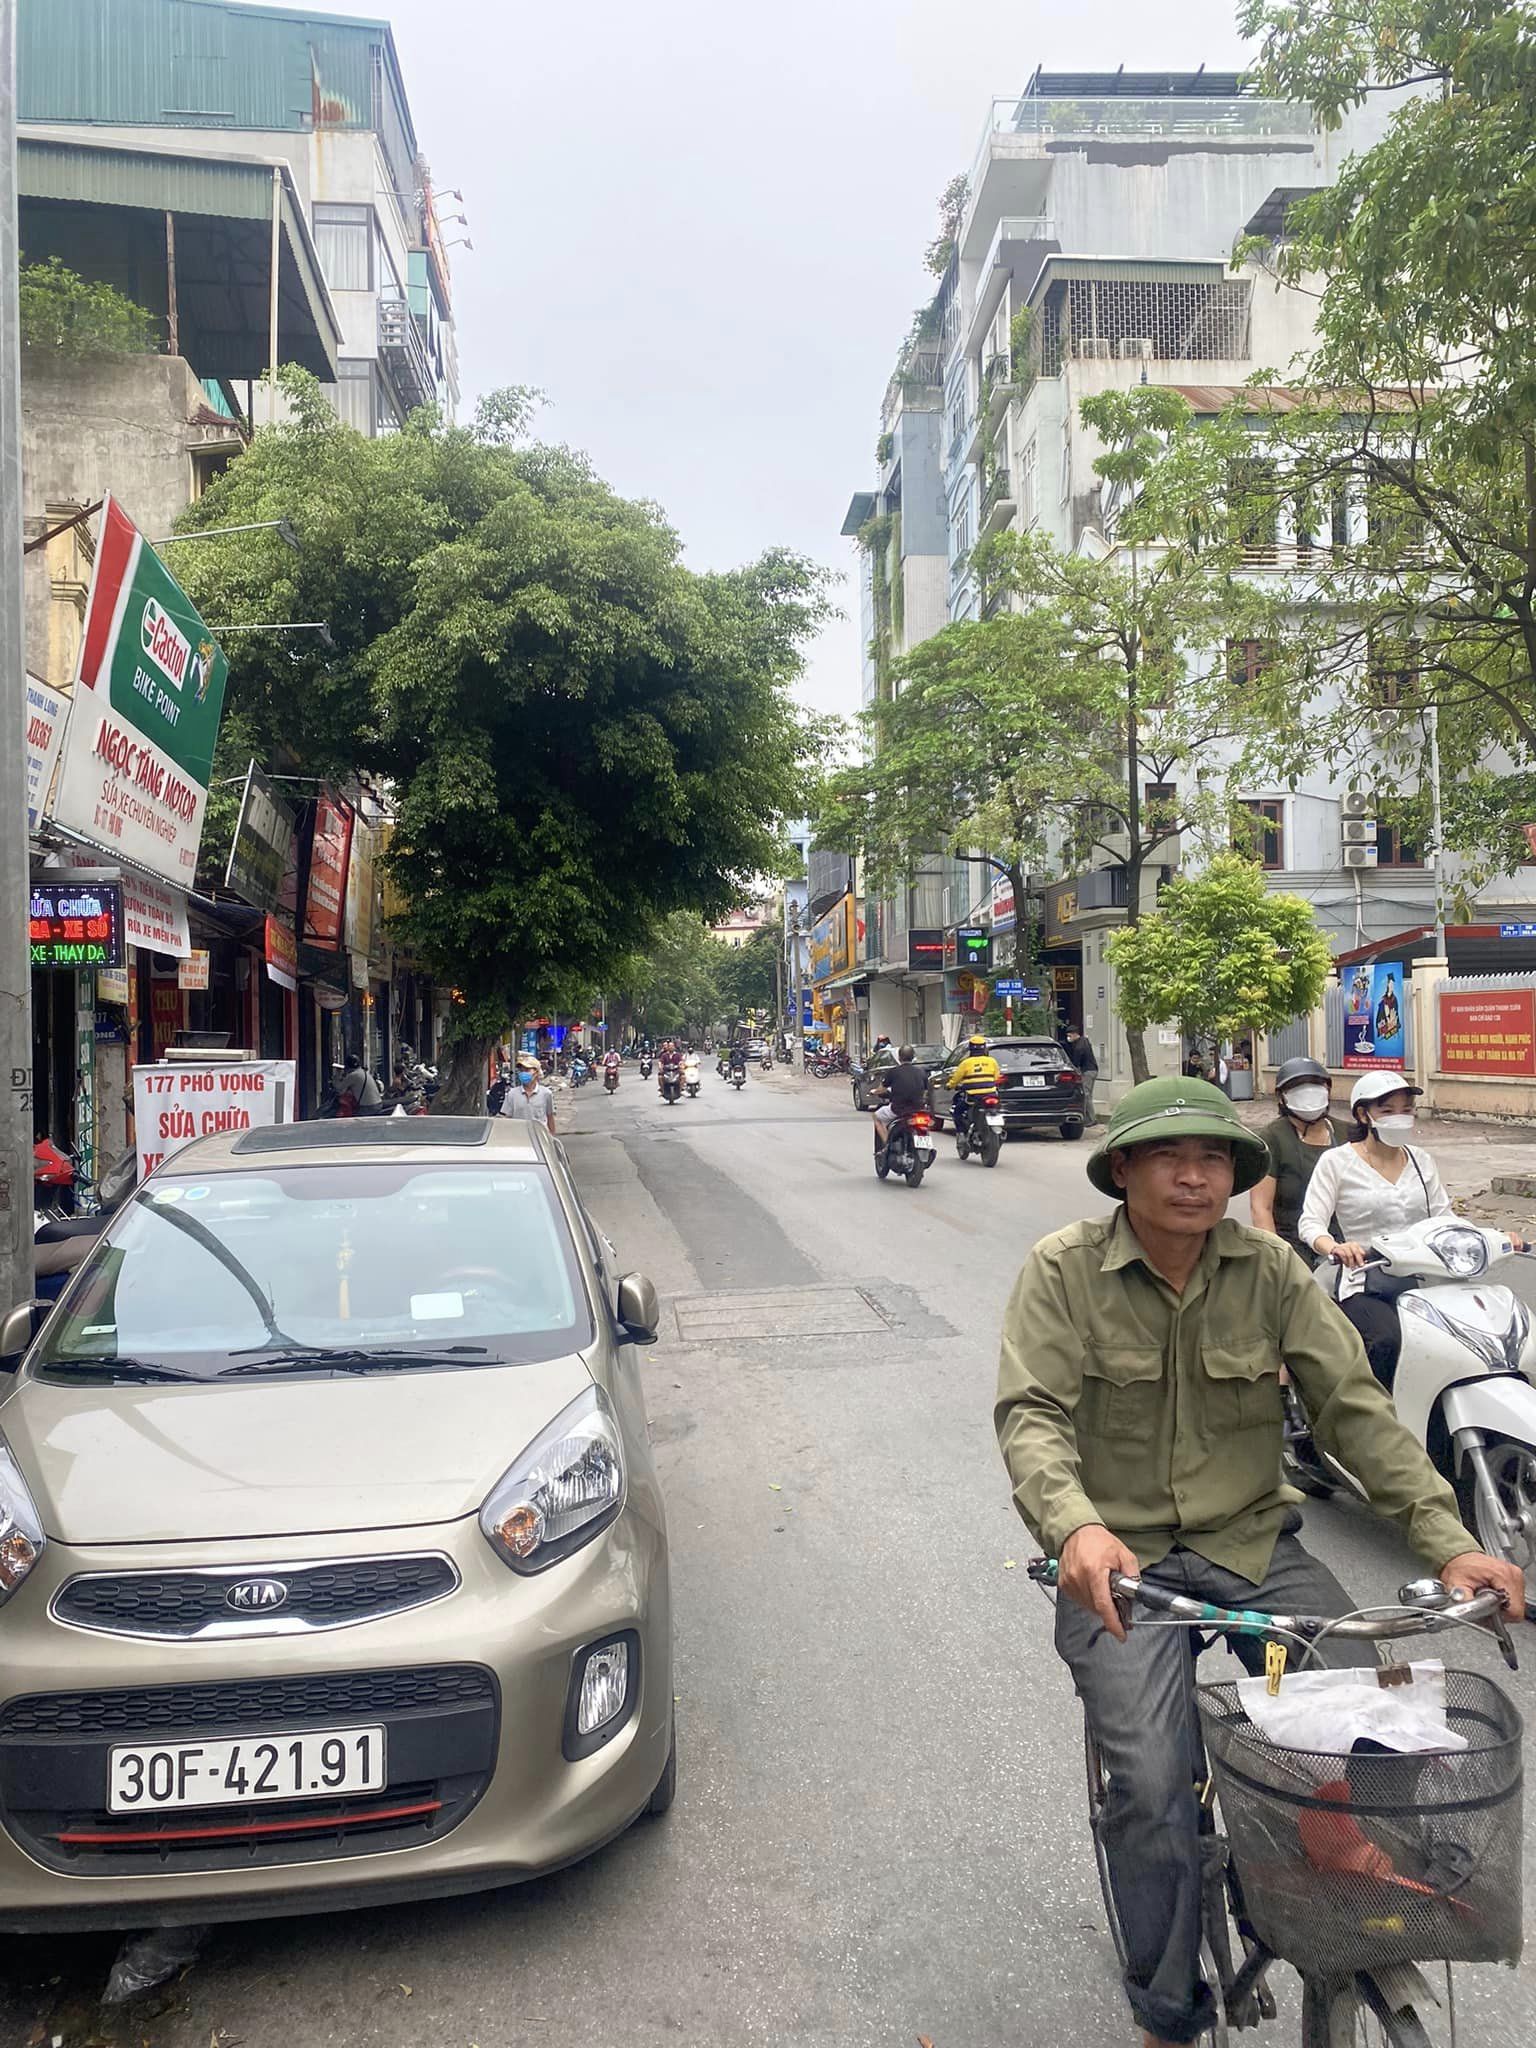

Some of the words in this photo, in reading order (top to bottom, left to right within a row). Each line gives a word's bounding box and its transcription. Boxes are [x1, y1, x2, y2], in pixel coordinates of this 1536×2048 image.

[152, 617, 188, 682] Castrol
[133, 665, 156, 704] BIKE
[155, 689, 181, 728] POINT
[96, 719, 138, 781] NGỌC
[163, 773, 197, 823] MOTOR
[117, 789, 130, 815] XE
[63, 920, 84, 938] XE
[145, 1076, 174, 1093] 177
[180, 1069, 214, 1093] PHỐ
[219, 1073, 265, 1096] VỌNG
[159, 1103, 196, 1139] SỬA
[201, 1106, 250, 1135] CHỮA
[235, 1584, 278, 1606] KIA
[118, 1734, 372, 1804] 30F-421.91
